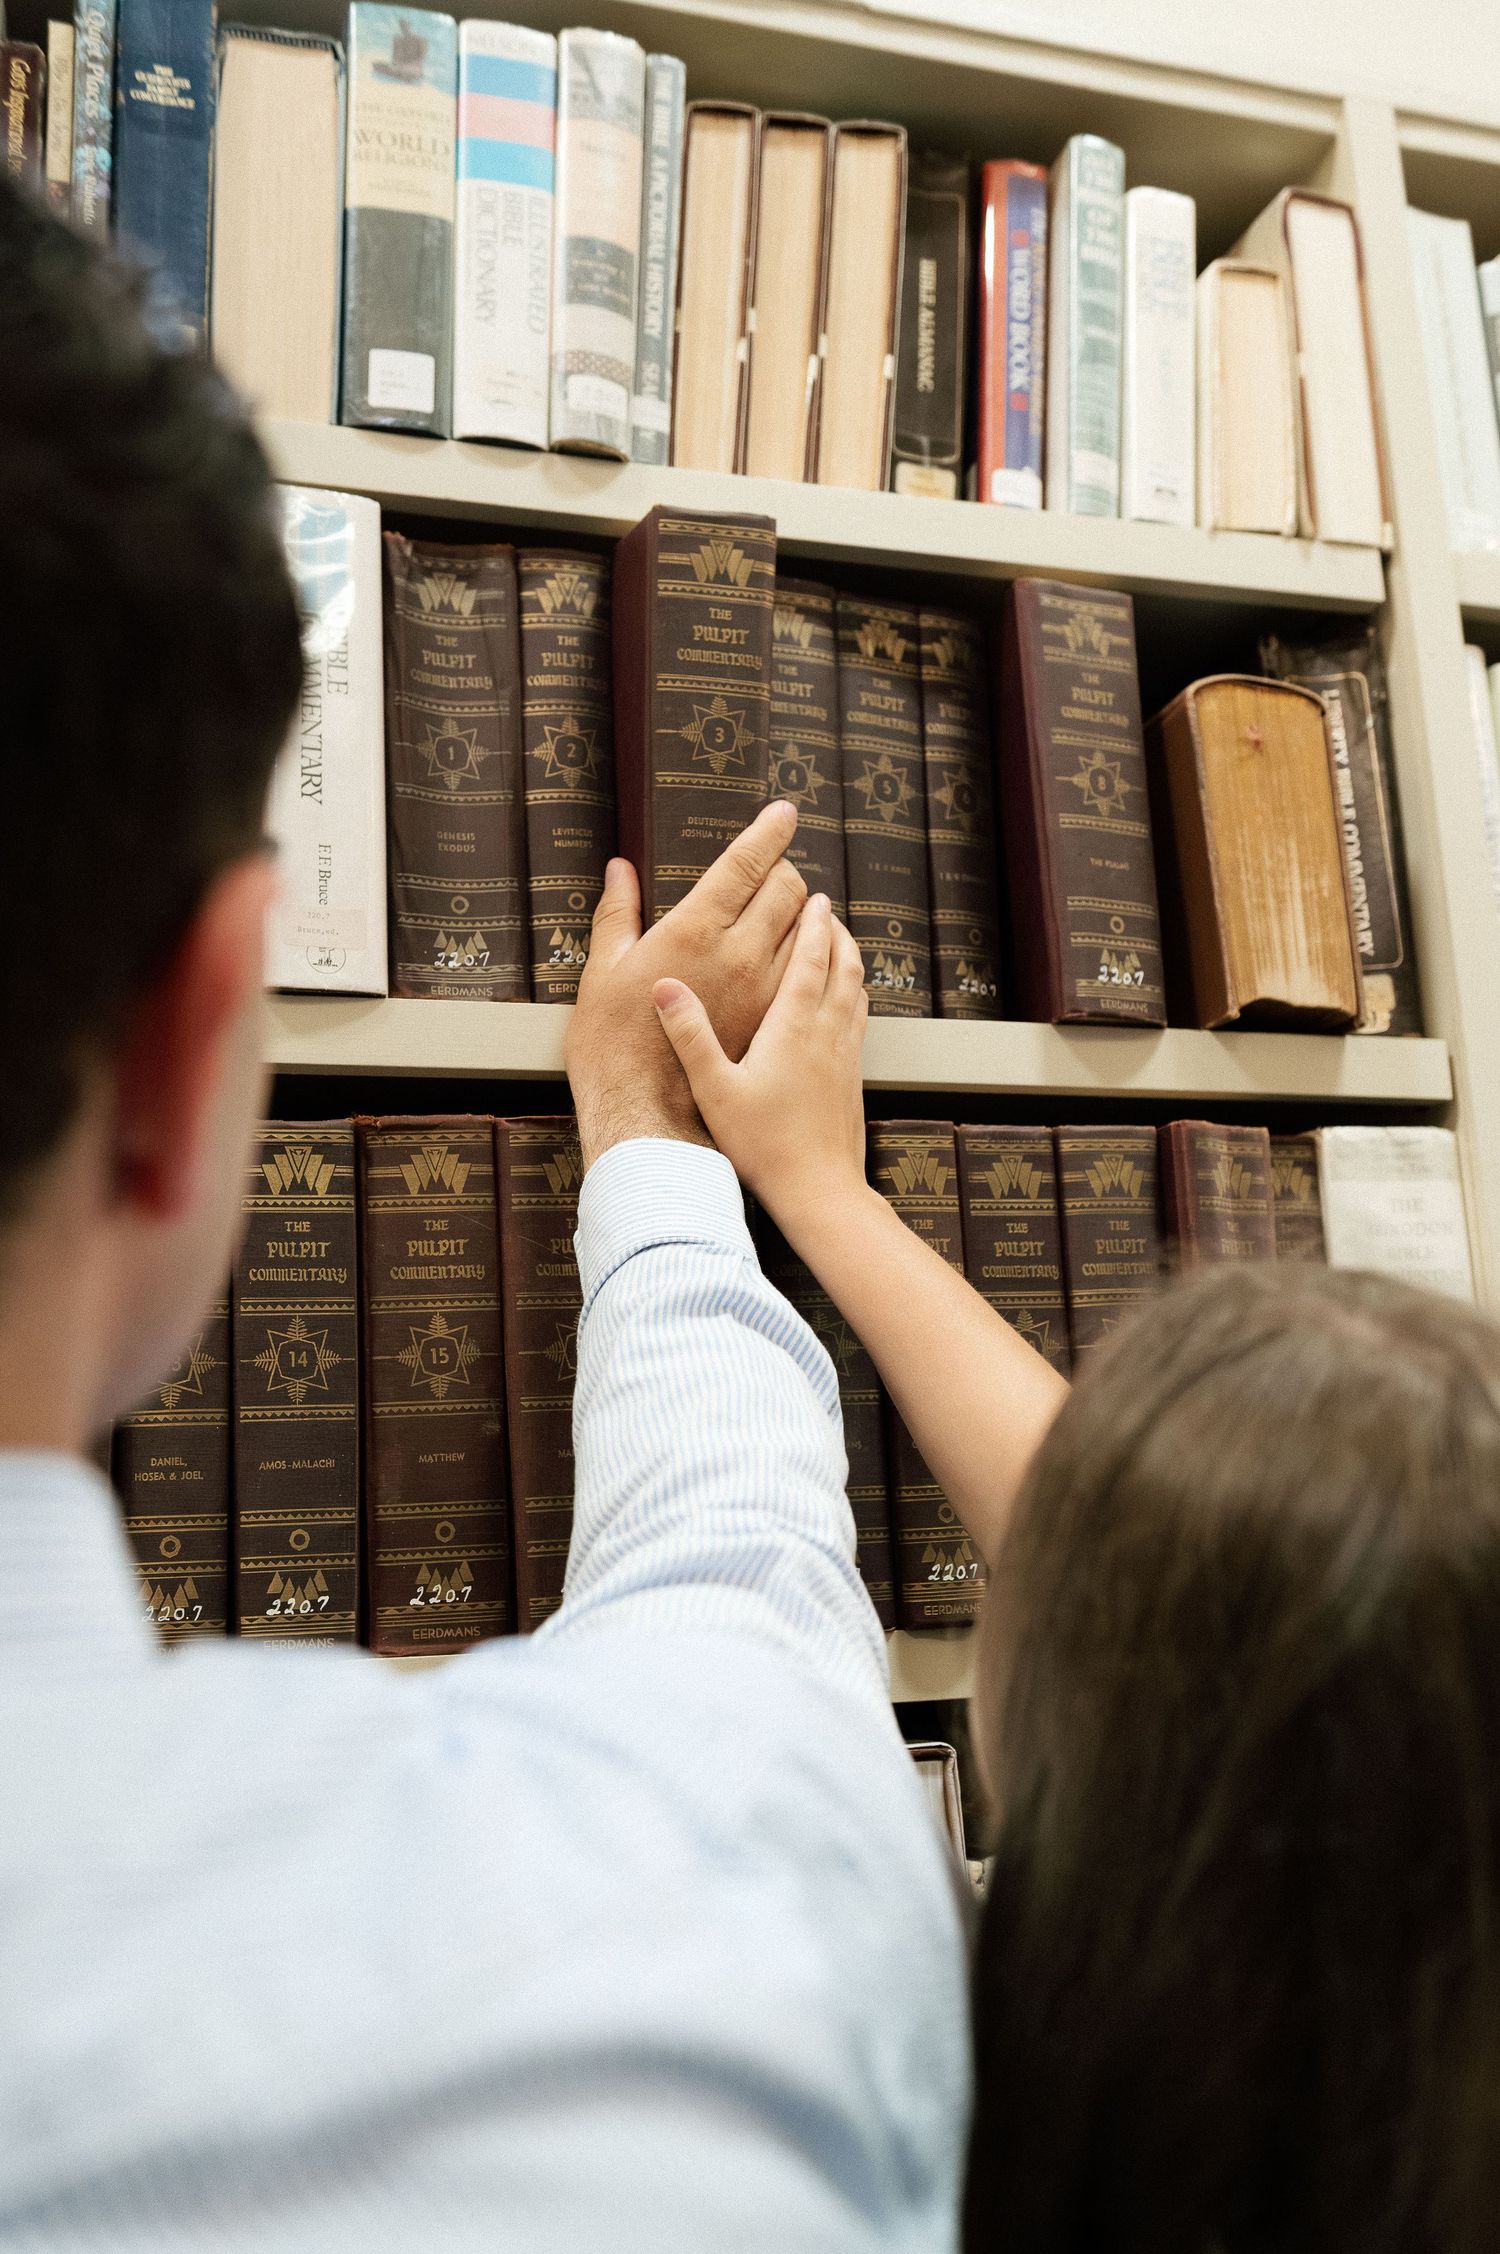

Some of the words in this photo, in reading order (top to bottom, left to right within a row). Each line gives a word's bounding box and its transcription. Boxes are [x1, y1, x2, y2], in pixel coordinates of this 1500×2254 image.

[84, 9, 106, 57] Quiet
[83, 61, 105, 119] Places
[353, 129, 451, 156] WORLD
[645, 173, 668, 259] PICTORIAL
[476, 188, 499, 327] DICTIONARY
[526, 193, 548, 337] ILLUSTRATED
[643, 261, 666, 340] HISTORY
[708, 607, 733, 621] THE
[436, 635, 458, 648] THE
[557, 635, 580, 647] THE
[692, 625, 750, 644] PULPIT
[422, 650, 477, 670] PULPIT
[676, 648, 763, 670] COMMENTARY
[777, 665, 799, 676] THE
[410, 669, 493, 691] COMMENTARY
[872, 678, 892, 690] THE
[1081, 672, 1101, 685] THE
[859, 691, 907, 712] PULPIT
[1071, 686, 1116, 706] PULPIT
[714, 727, 725, 743] 3
[447, 746, 456, 761] 1
[567, 743, 577, 758] 2
[788, 769, 797, 783] 4
[883, 781, 892, 795] 5
[437, 830, 476, 842] GENESIS
[552, 827, 593, 839] LEVITICUS
[681, 828, 713, 839] JOSHUA
[438, 842, 476, 854] EXODUS
[554, 839, 593, 850] NUMBERS
[318, 869, 332, 906] Bruce
[433, 951, 490, 968] 220.7
[430, 985, 494, 998] EERDMANS
[548, 983, 578, 993] EERD
[872, 1003, 923, 1017] EERDMANS
[1100, 998, 1149, 1013] EERDMANS
[284, 1220, 311, 1232] THE
[423, 1219, 449, 1231] THE
[912, 1219, 935, 1230] THE
[1006, 1222, 1029, 1234] THE
[1108, 1220, 1131, 1231] THE
[266, 1241, 331, 1258] PULPIT
[406, 1238, 469, 1257] PULPIT
[994, 1239, 1045, 1257] PULPIT
[1095, 1238, 1148, 1254] PULPIT
[249, 1267, 347, 1284] COMMENTARY
[389, 1263, 486, 1281] COMMENTARY
[982, 1264, 1060, 1280] COMMENTARY
[288, 1350, 309, 1368] 14
[430, 1347, 450, 1365] 15
[150, 1457, 188, 1468] DANIEL,
[418, 1452, 465, 1464] MATTHEW
[134, 1472, 166, 1482] HOSEA
[169, 1472, 177, 1481] &
[180, 1470, 204, 1481] JOEL
[927, 1563, 979, 1581] 220.7
[409, 1584, 473, 1607] 220.7
[141, 1605, 203, 1621] 220.7
[265, 1595, 330, 1616] 220.7
[924, 1603, 983, 1616] EERDMANS
[412, 1626, 481, 1640] EERDMANS
[263, 1637, 335, 1650] EERDMANS
